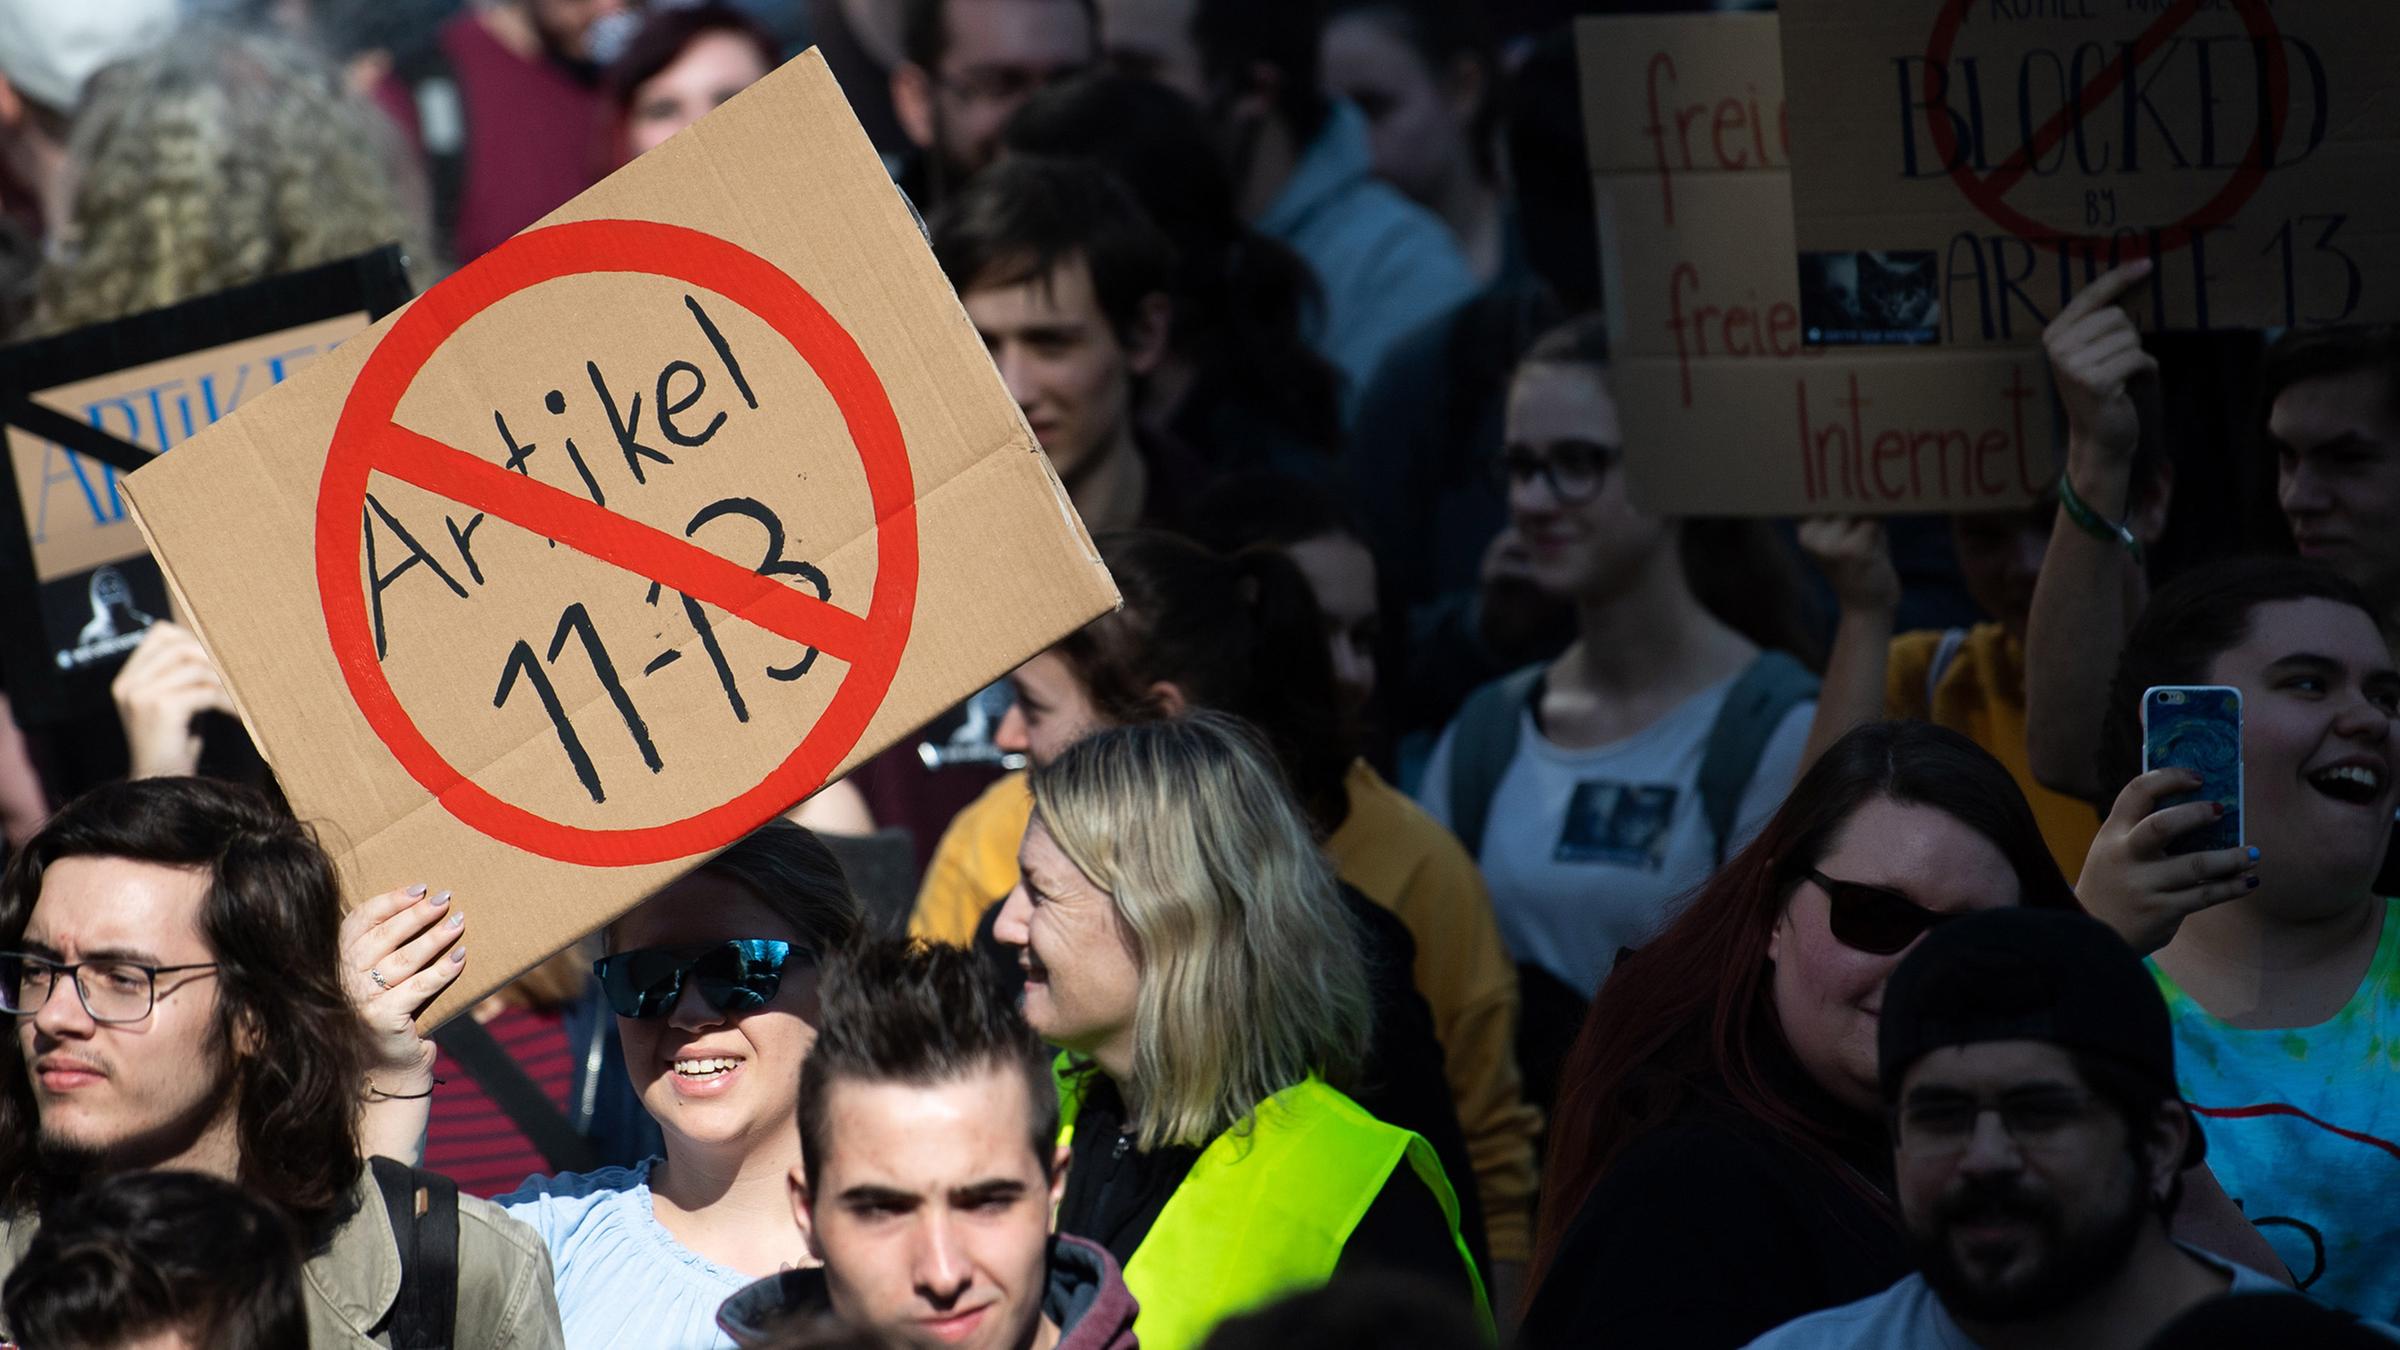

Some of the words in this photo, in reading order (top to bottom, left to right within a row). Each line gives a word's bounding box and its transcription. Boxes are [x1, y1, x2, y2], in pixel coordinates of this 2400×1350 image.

[1891, 36, 2328, 178] BLOCKED
[2085, 189, 2117, 226] BY
[2262, 213, 2362, 329] 13
[1665, 261, 1827, 409] freie
[363, 294, 758, 661] Artikel
[1796, 365, 2048, 503] Internet
[493, 496, 832, 804] 11-13
